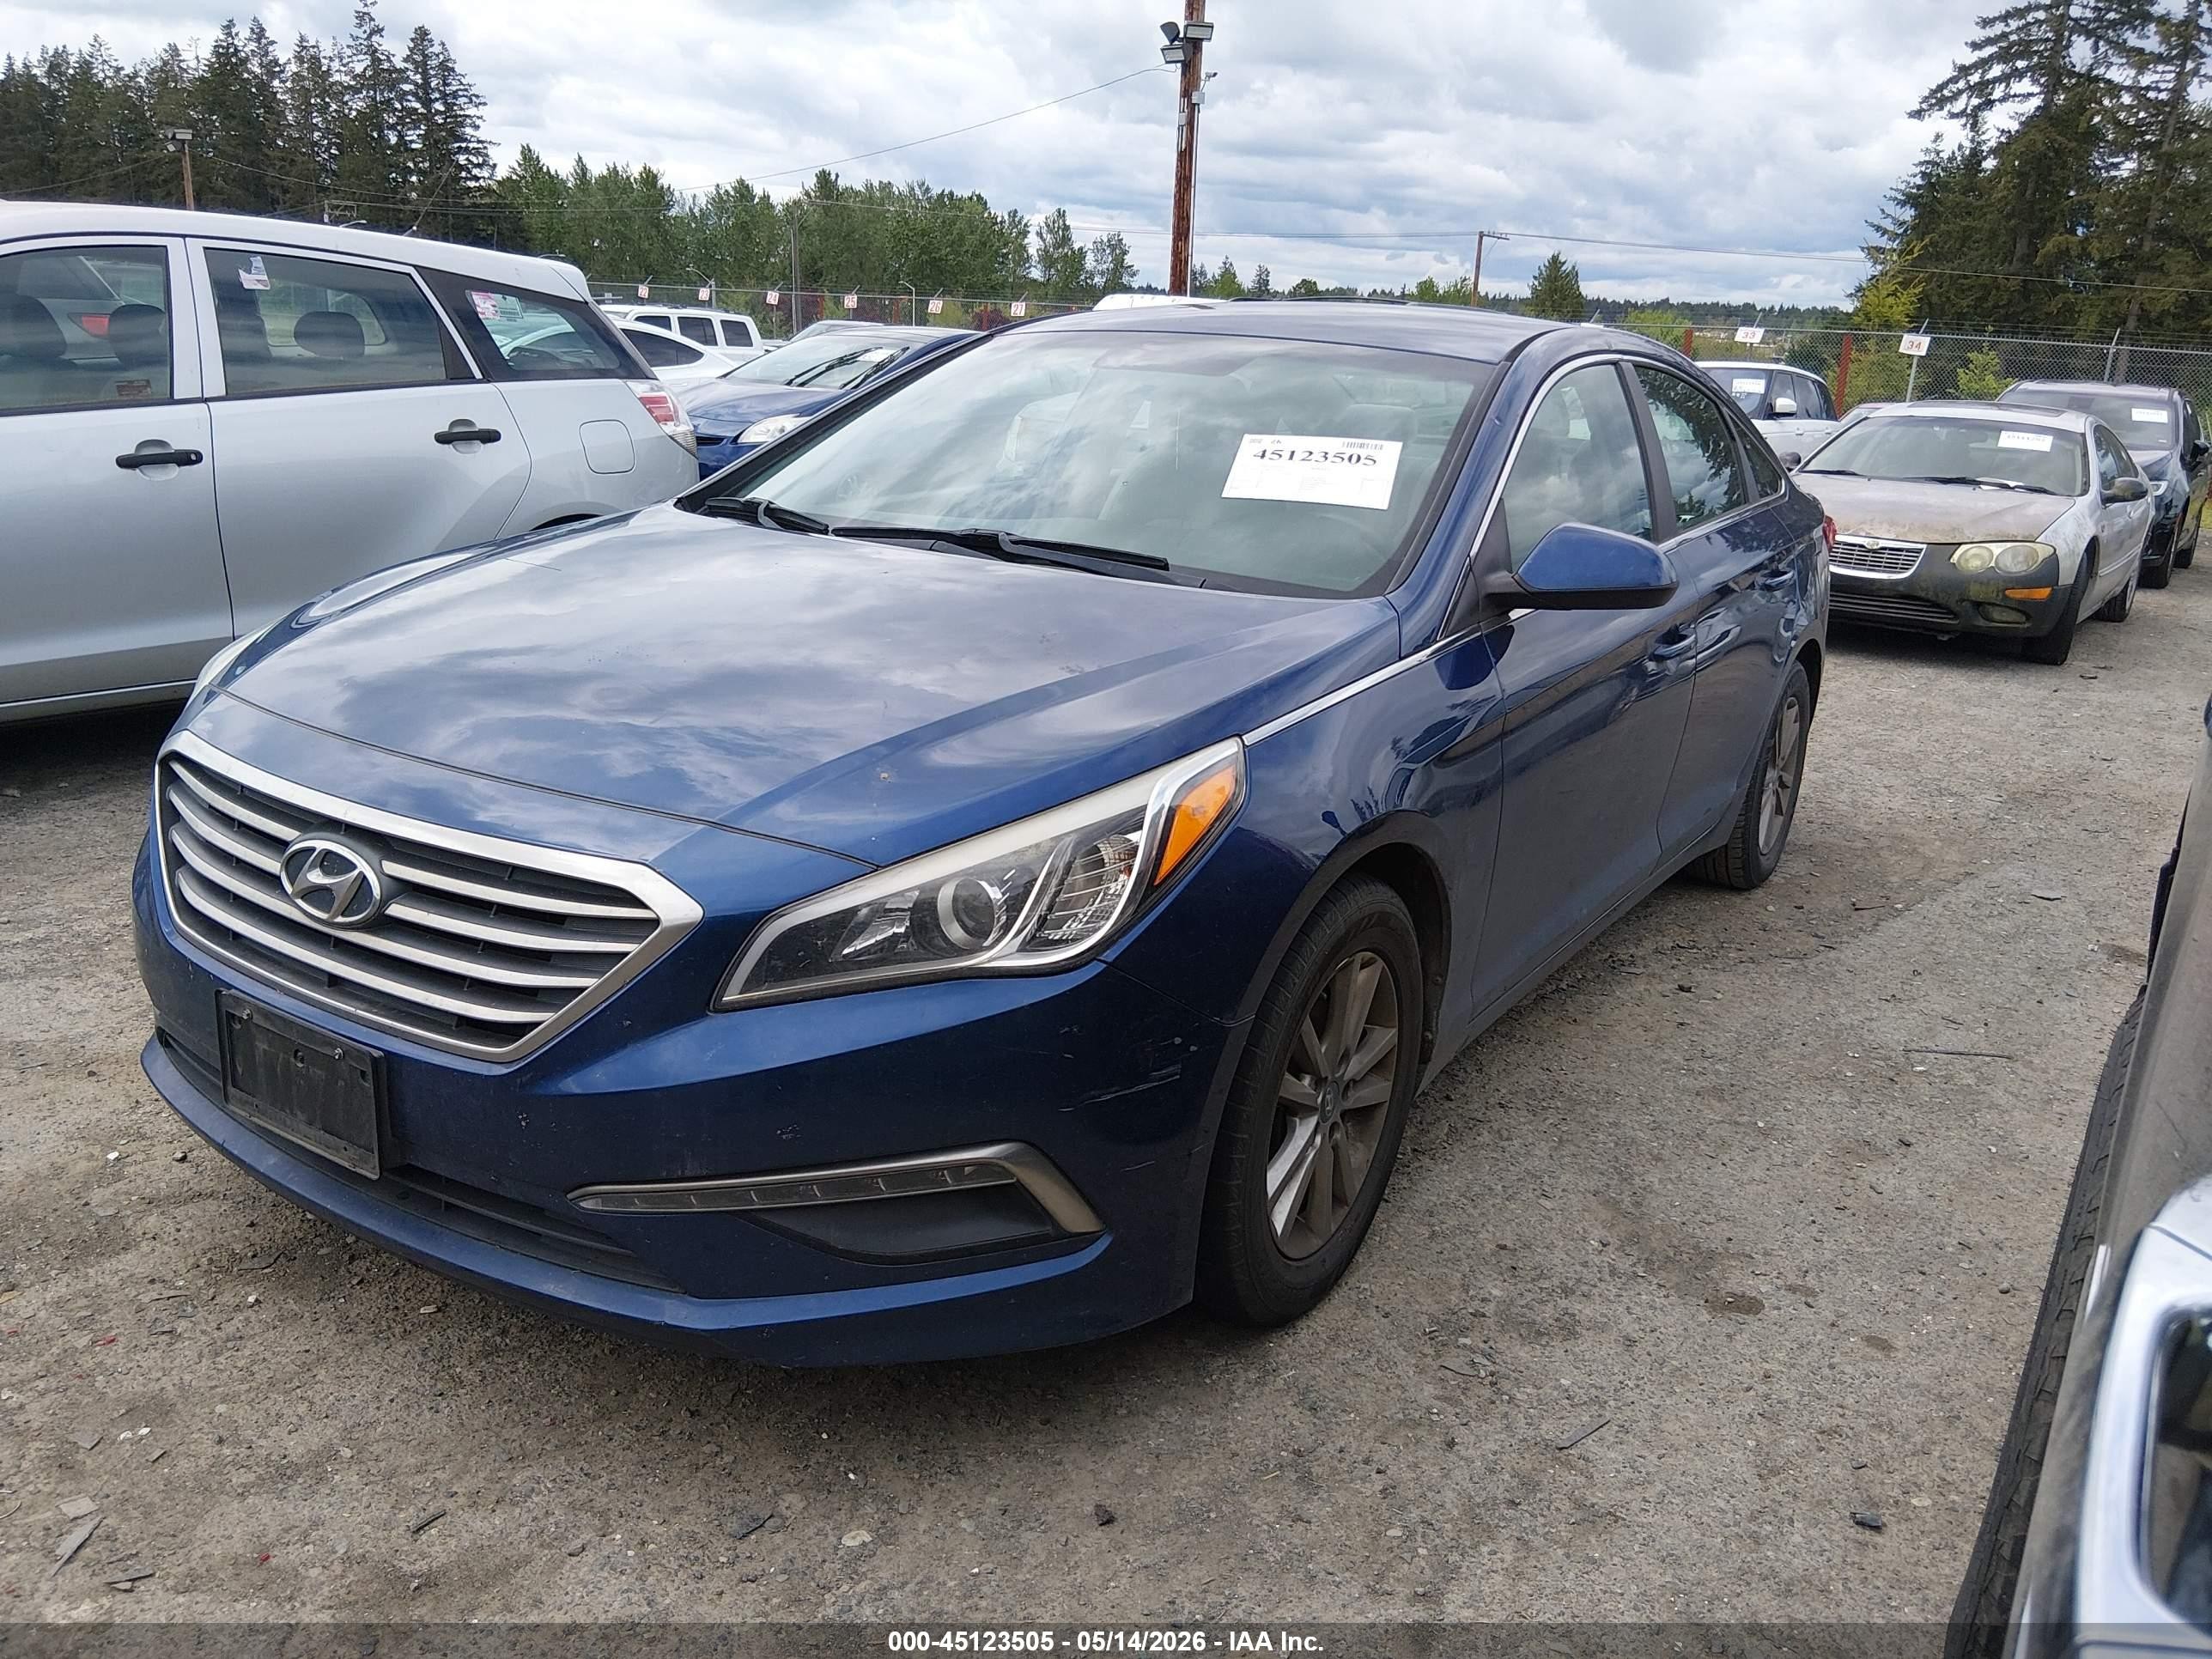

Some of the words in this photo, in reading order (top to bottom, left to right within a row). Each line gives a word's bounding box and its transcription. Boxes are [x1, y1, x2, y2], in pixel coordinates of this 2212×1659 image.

[640, 288, 647, 297] 22
[701, 289, 708, 299] 23
[769, 293, 777, 303] 24
[846, 296, 855, 307] 25
[930, 301, 940, 312] 26
[1013, 304, 1024, 314] 27
[1907, 341, 1921, 351] 34
[1253, 448, 1376, 466] 45123505
